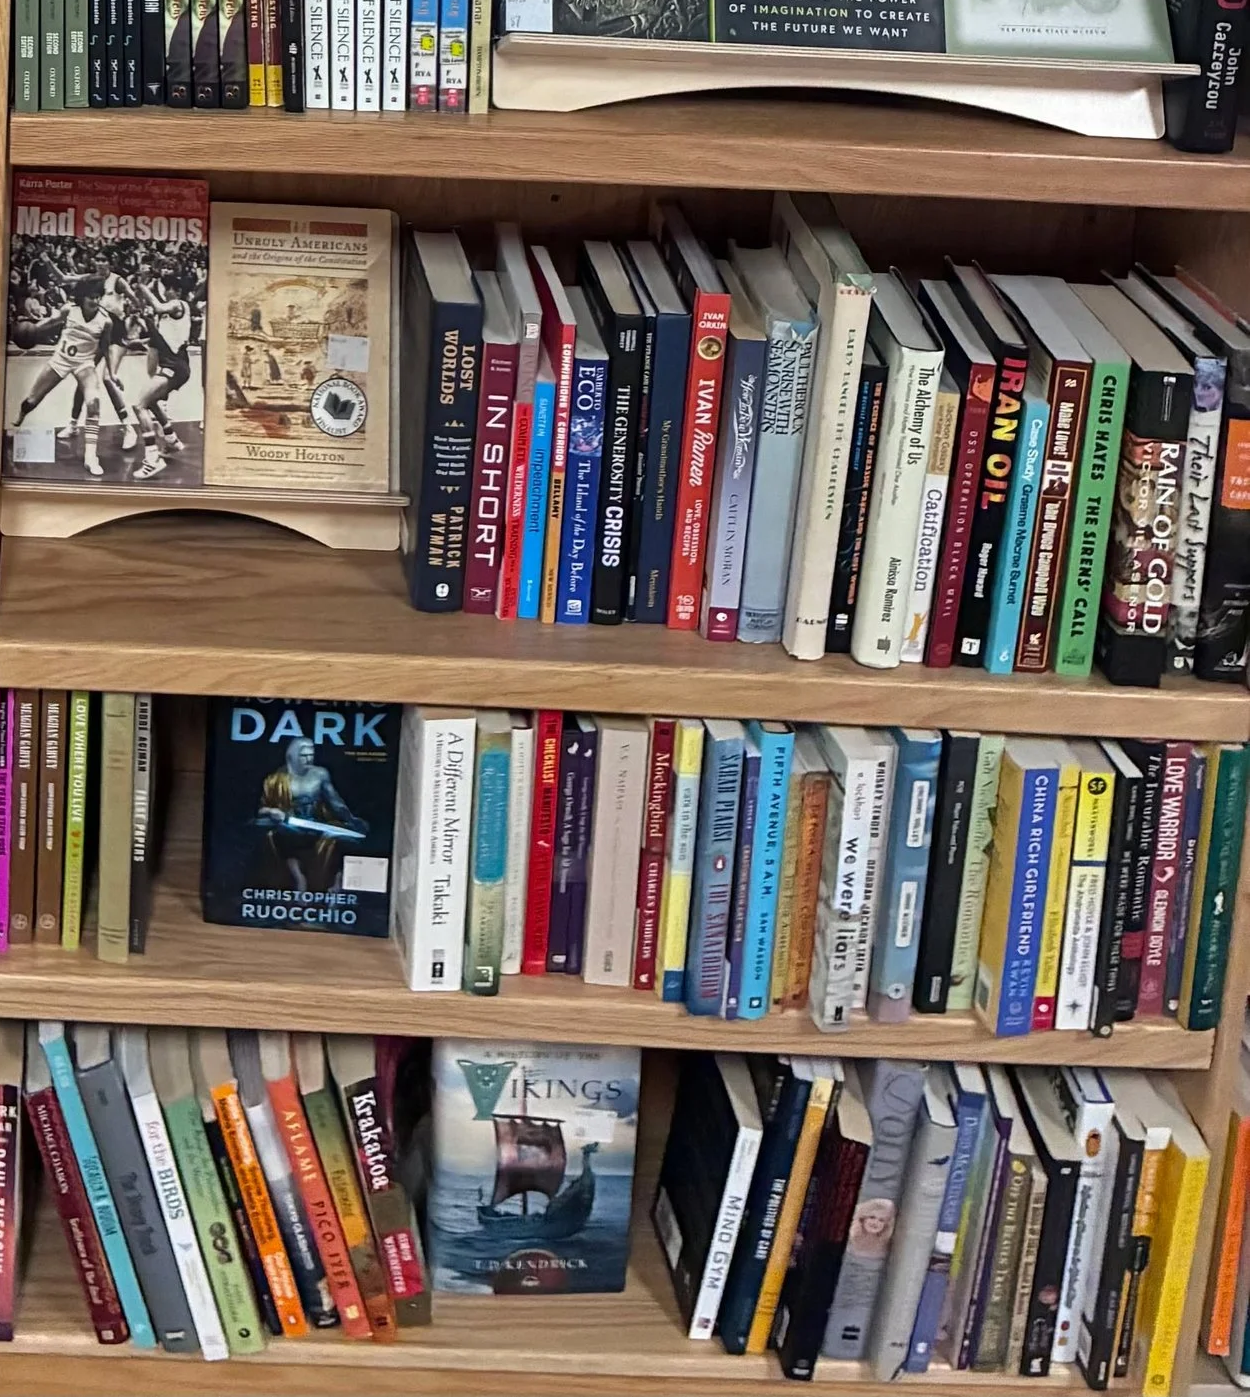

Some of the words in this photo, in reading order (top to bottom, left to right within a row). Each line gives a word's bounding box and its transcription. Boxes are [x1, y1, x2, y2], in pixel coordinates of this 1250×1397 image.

[310, 6, 324, 61] SILENCE
[16, 205, 75, 238] Mad
[83, 208, 204, 243] Seasons
[484, 394, 509, 430] IN
[990, 357, 1027, 442] IRAN
[1098, 374, 1118, 428] CHRIS
[1091, 431, 1111, 482] HAYES
[474, 443, 505, 568] SHORT
[980, 453, 1014, 512] OIL
[1084, 496, 1102, 526] THE
[1077, 528, 1099, 595] SIRENS'
[1070, 599, 1092, 638] CALL
[229, 706, 388, 748] DARK
[448, 731, 464, 747] A
[444, 750, 464, 811] Different
[1030, 774, 1049, 824] CHINA
[443, 815, 463, 866] Mirror
[1026, 827, 1044, 864] RICH
[241, 888, 358, 906] CHRISTOPHER
[241, 904, 358, 926] RUOCCHIO
[431, 874, 452, 927] Takaki
[1018, 867, 1041, 956] GIRLFRIEND
[352, 1091, 390, 1193] Krakatoa
[717, 1195, 743, 1245] MIND
[706, 1251, 732, 1290] GYM
